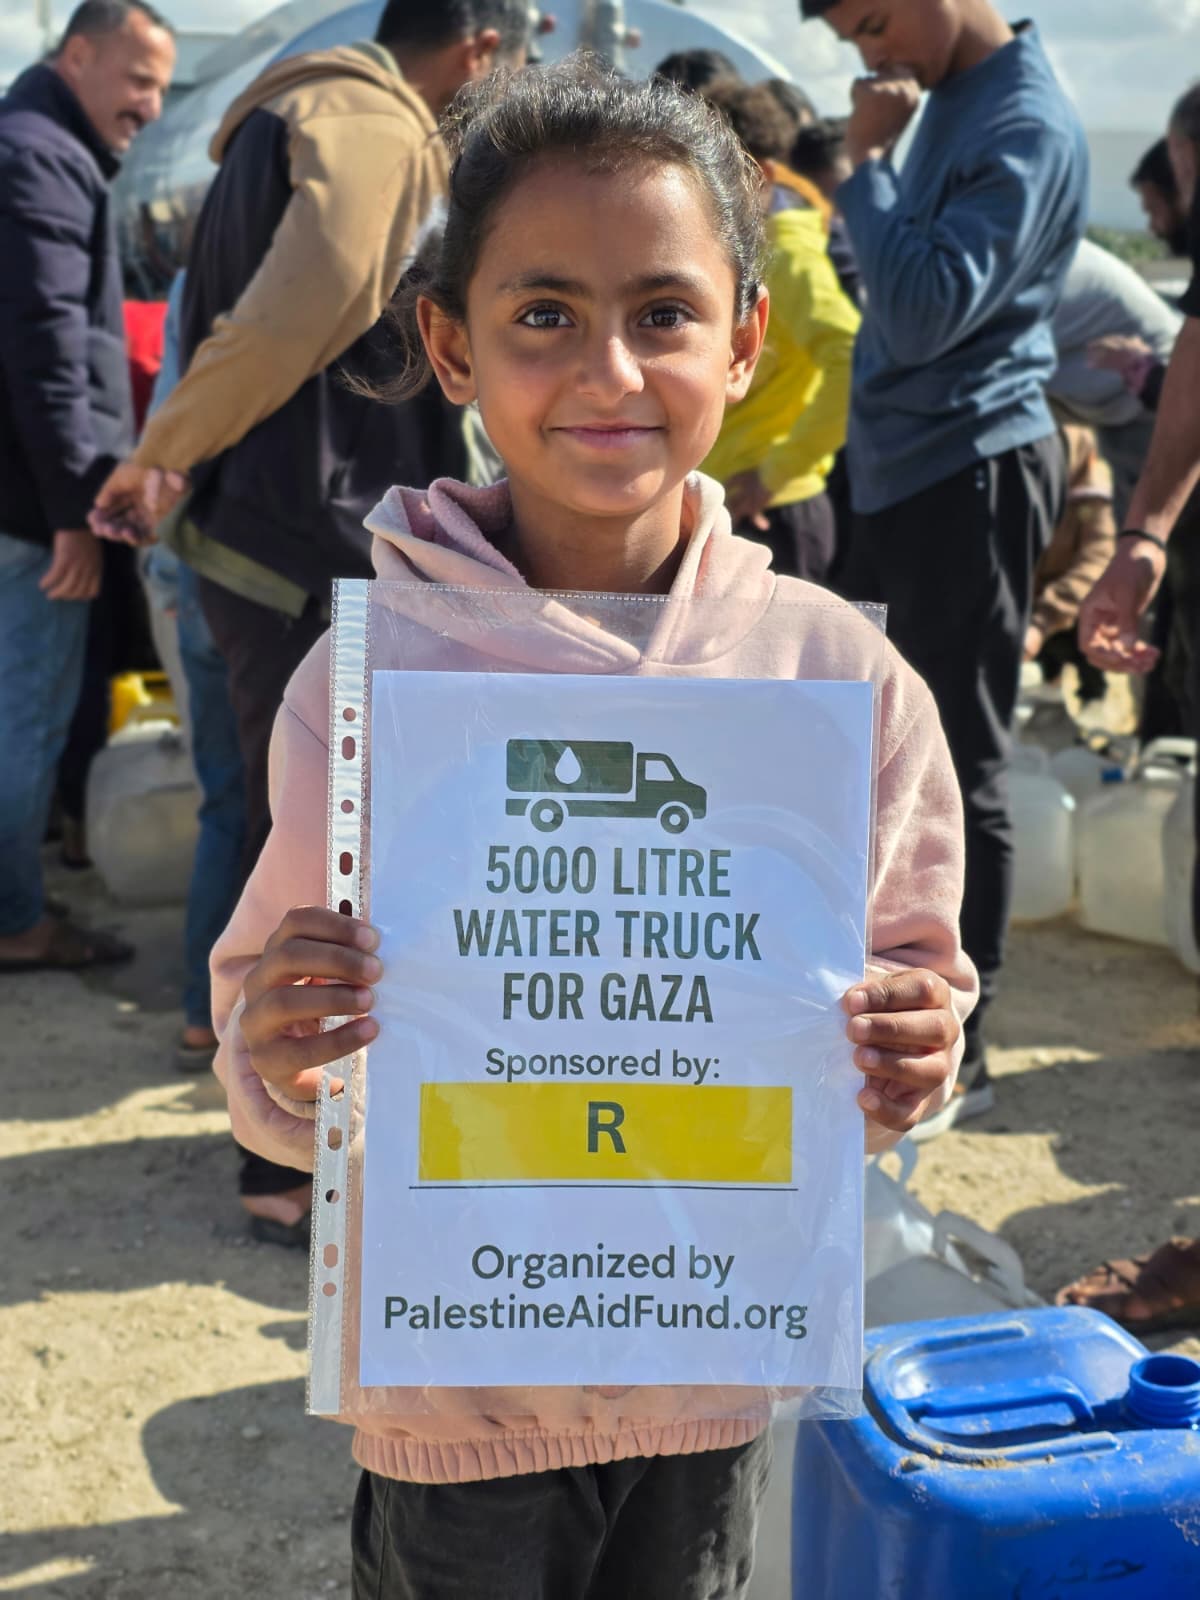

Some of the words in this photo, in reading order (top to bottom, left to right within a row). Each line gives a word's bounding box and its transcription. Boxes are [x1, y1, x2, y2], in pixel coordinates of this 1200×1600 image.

[486, 845, 596, 894] 5000
[613, 847, 731, 897] LITRE
[453, 909, 600, 957] WATER
[615, 910, 762, 961] TRUCK
[503, 972, 584, 1021] FOR
[600, 973, 714, 1023] GAZA
[486, 1048, 661, 1082] Sponsored
[672, 1049, 720, 1086] by:
[587, 1100, 627, 1154] R
[471, 1242, 675, 1289] Organized
[689, 1245, 735, 1289] by
[384, 1293, 808, 1340] PalestineAidFund.org
